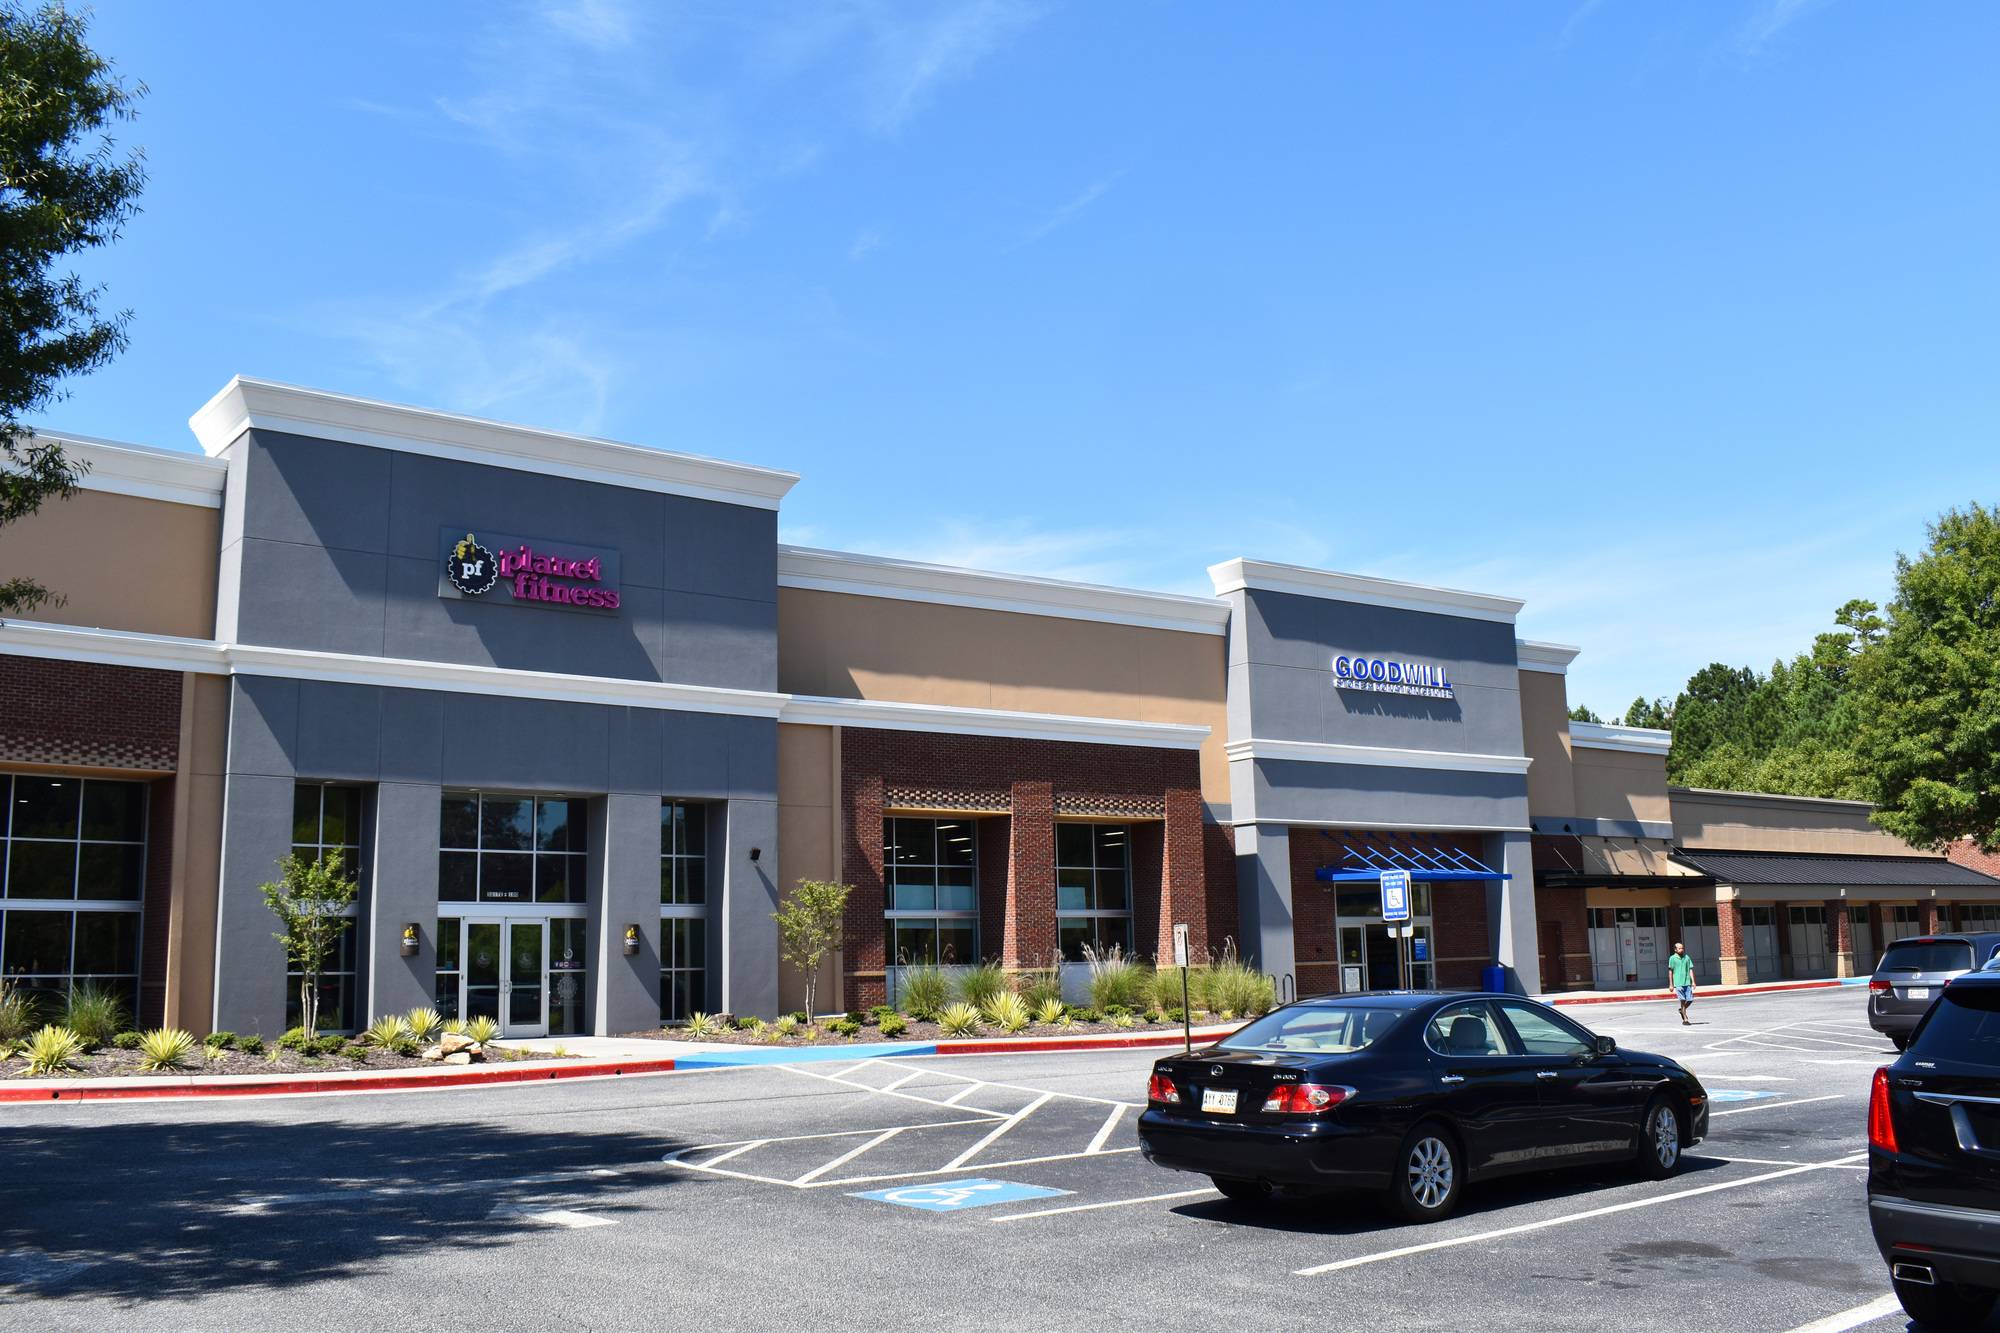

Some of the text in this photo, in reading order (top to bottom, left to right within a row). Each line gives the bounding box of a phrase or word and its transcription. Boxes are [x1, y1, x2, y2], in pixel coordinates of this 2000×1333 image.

[462, 560, 485, 579] pf
[500, 546, 602, 581] planet
[513, 573, 620, 609] fitness
[1332, 655, 1452, 689] GOODWILL
